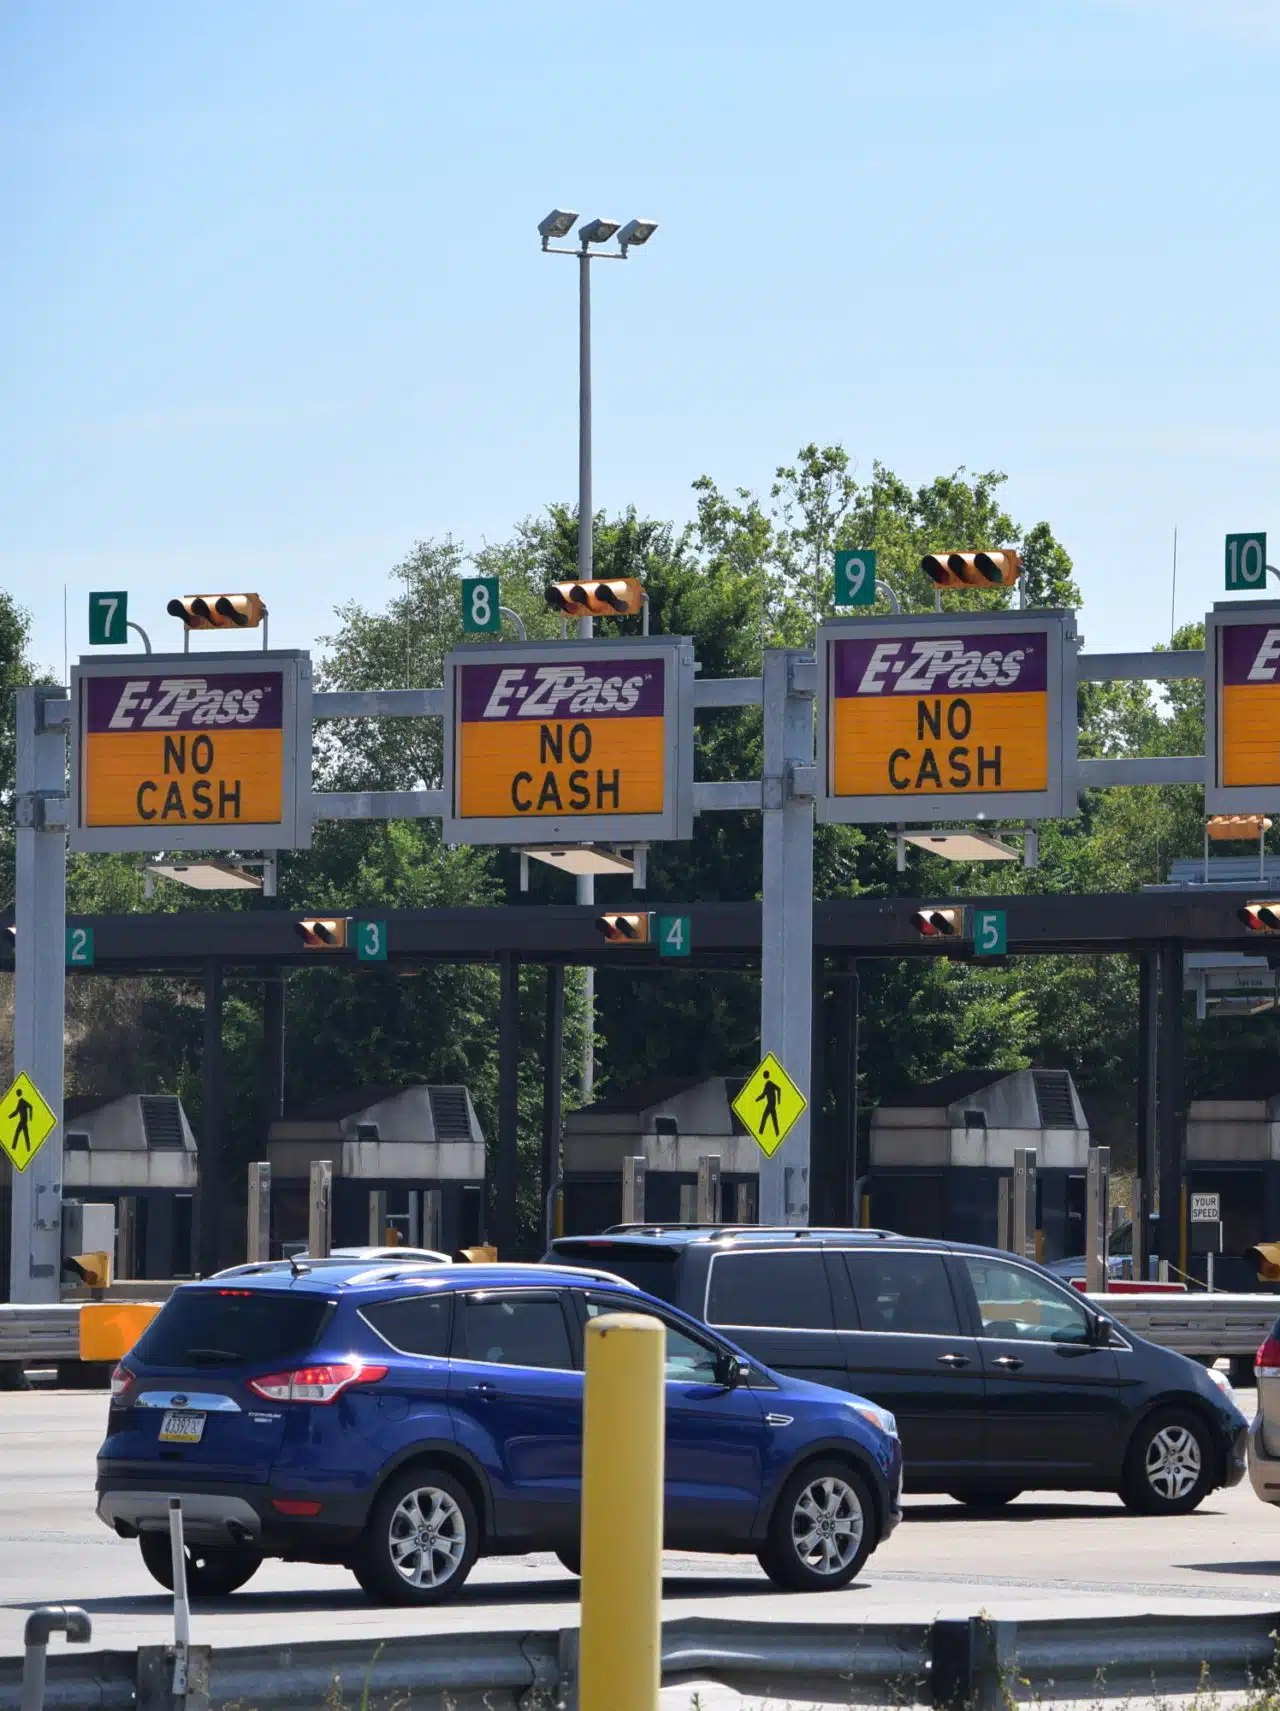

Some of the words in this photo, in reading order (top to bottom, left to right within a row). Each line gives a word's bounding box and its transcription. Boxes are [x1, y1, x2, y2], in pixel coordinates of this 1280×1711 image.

[846, 558, 865, 596] 9
[1229, 540, 1262, 582] 10
[99, 599, 117, 637] 7
[472, 585, 490, 625] 8
[918, 698, 971, 740] NO
[164, 734, 213, 774] NO
[540, 723, 591, 764] NO
[889, 746, 1001, 789] CASH
[137, 780, 240, 820] CASH
[512, 769, 621, 811] CASH
[72, 931, 86, 960] 2
[365, 924, 379, 954] 3
[667, 919, 682, 949] 4
[983, 916, 998, 948] 5
[1193, 1208, 1217, 1218] SPEED
[1195, 1197, 1216, 1206] YOUR
